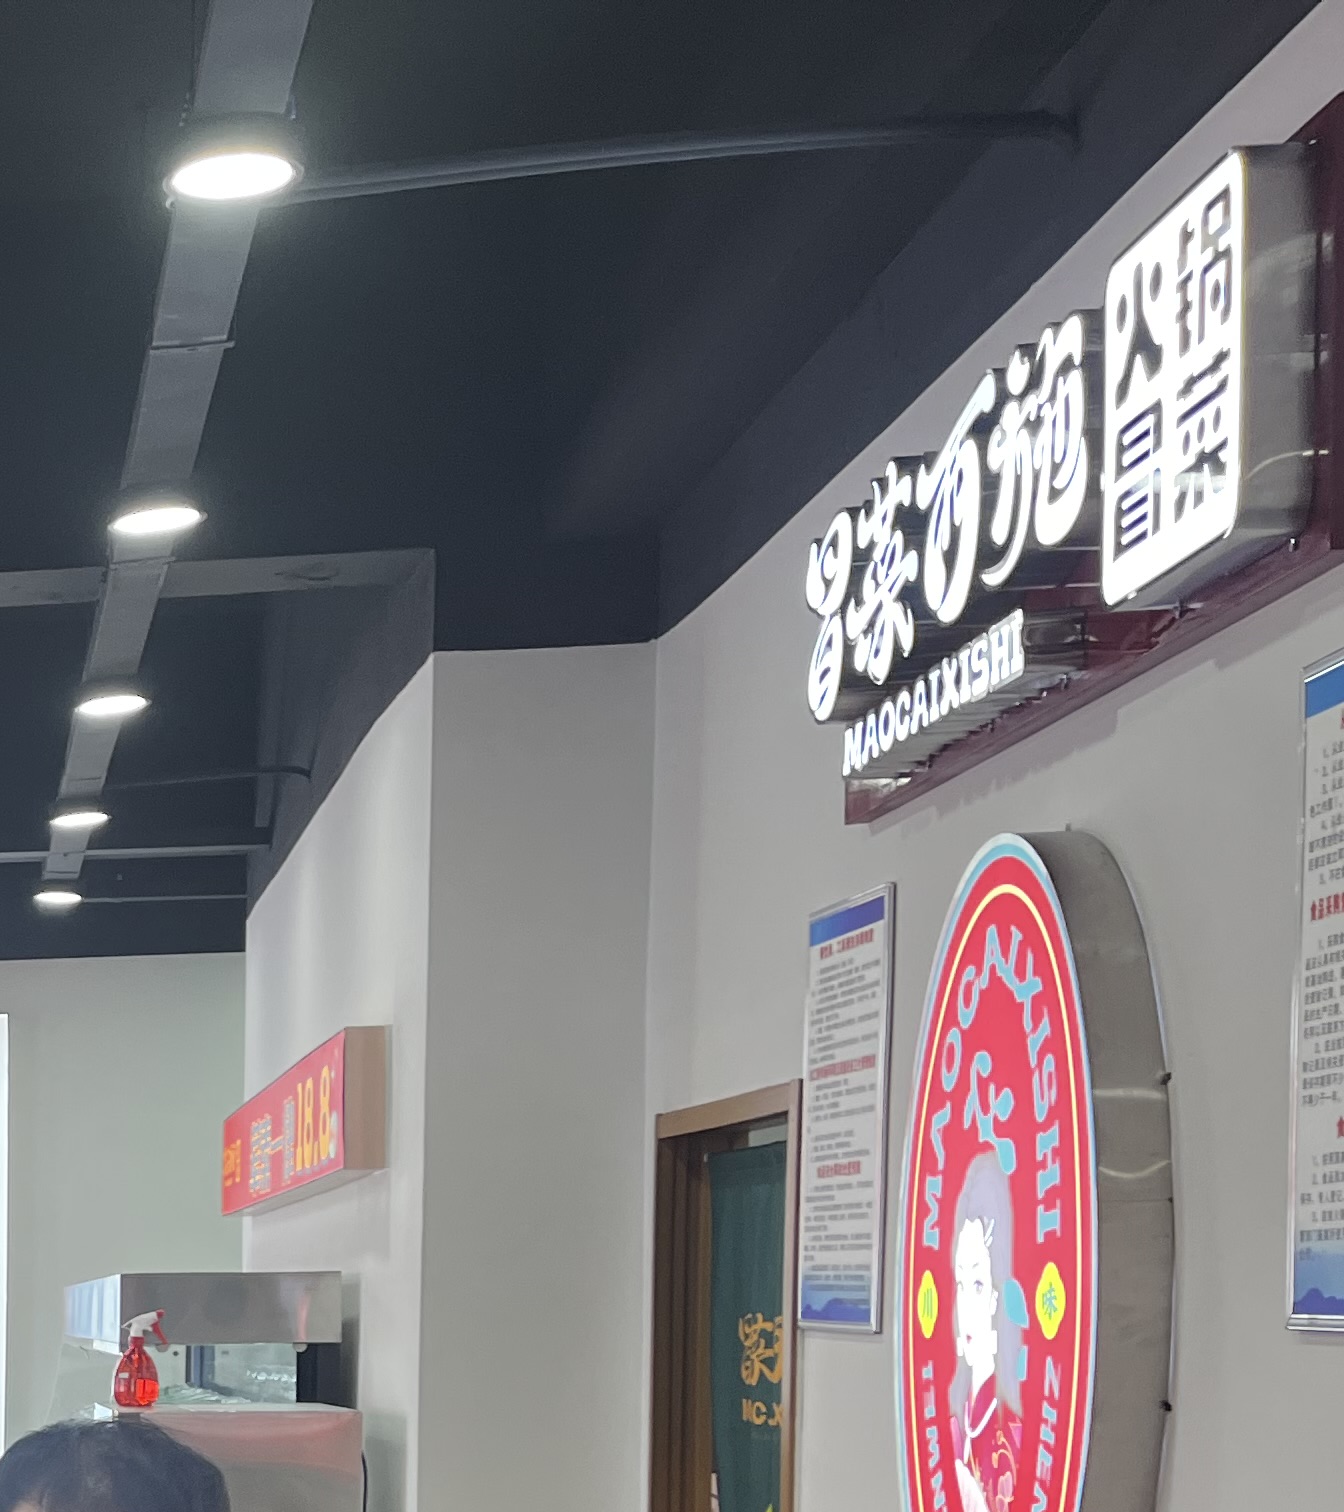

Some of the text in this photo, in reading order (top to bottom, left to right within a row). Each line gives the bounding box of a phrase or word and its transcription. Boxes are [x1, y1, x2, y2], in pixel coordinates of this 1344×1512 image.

[1112, 185, 1231, 401] 火锅
[1111, 349, 1230, 562] 冒菜
[842, 608, 1025, 777] MAOCAIXISHI
[923, 924, 1061, 1248] MAOCAIXISHI
[1041, 1280, 1060, 1322] 味
